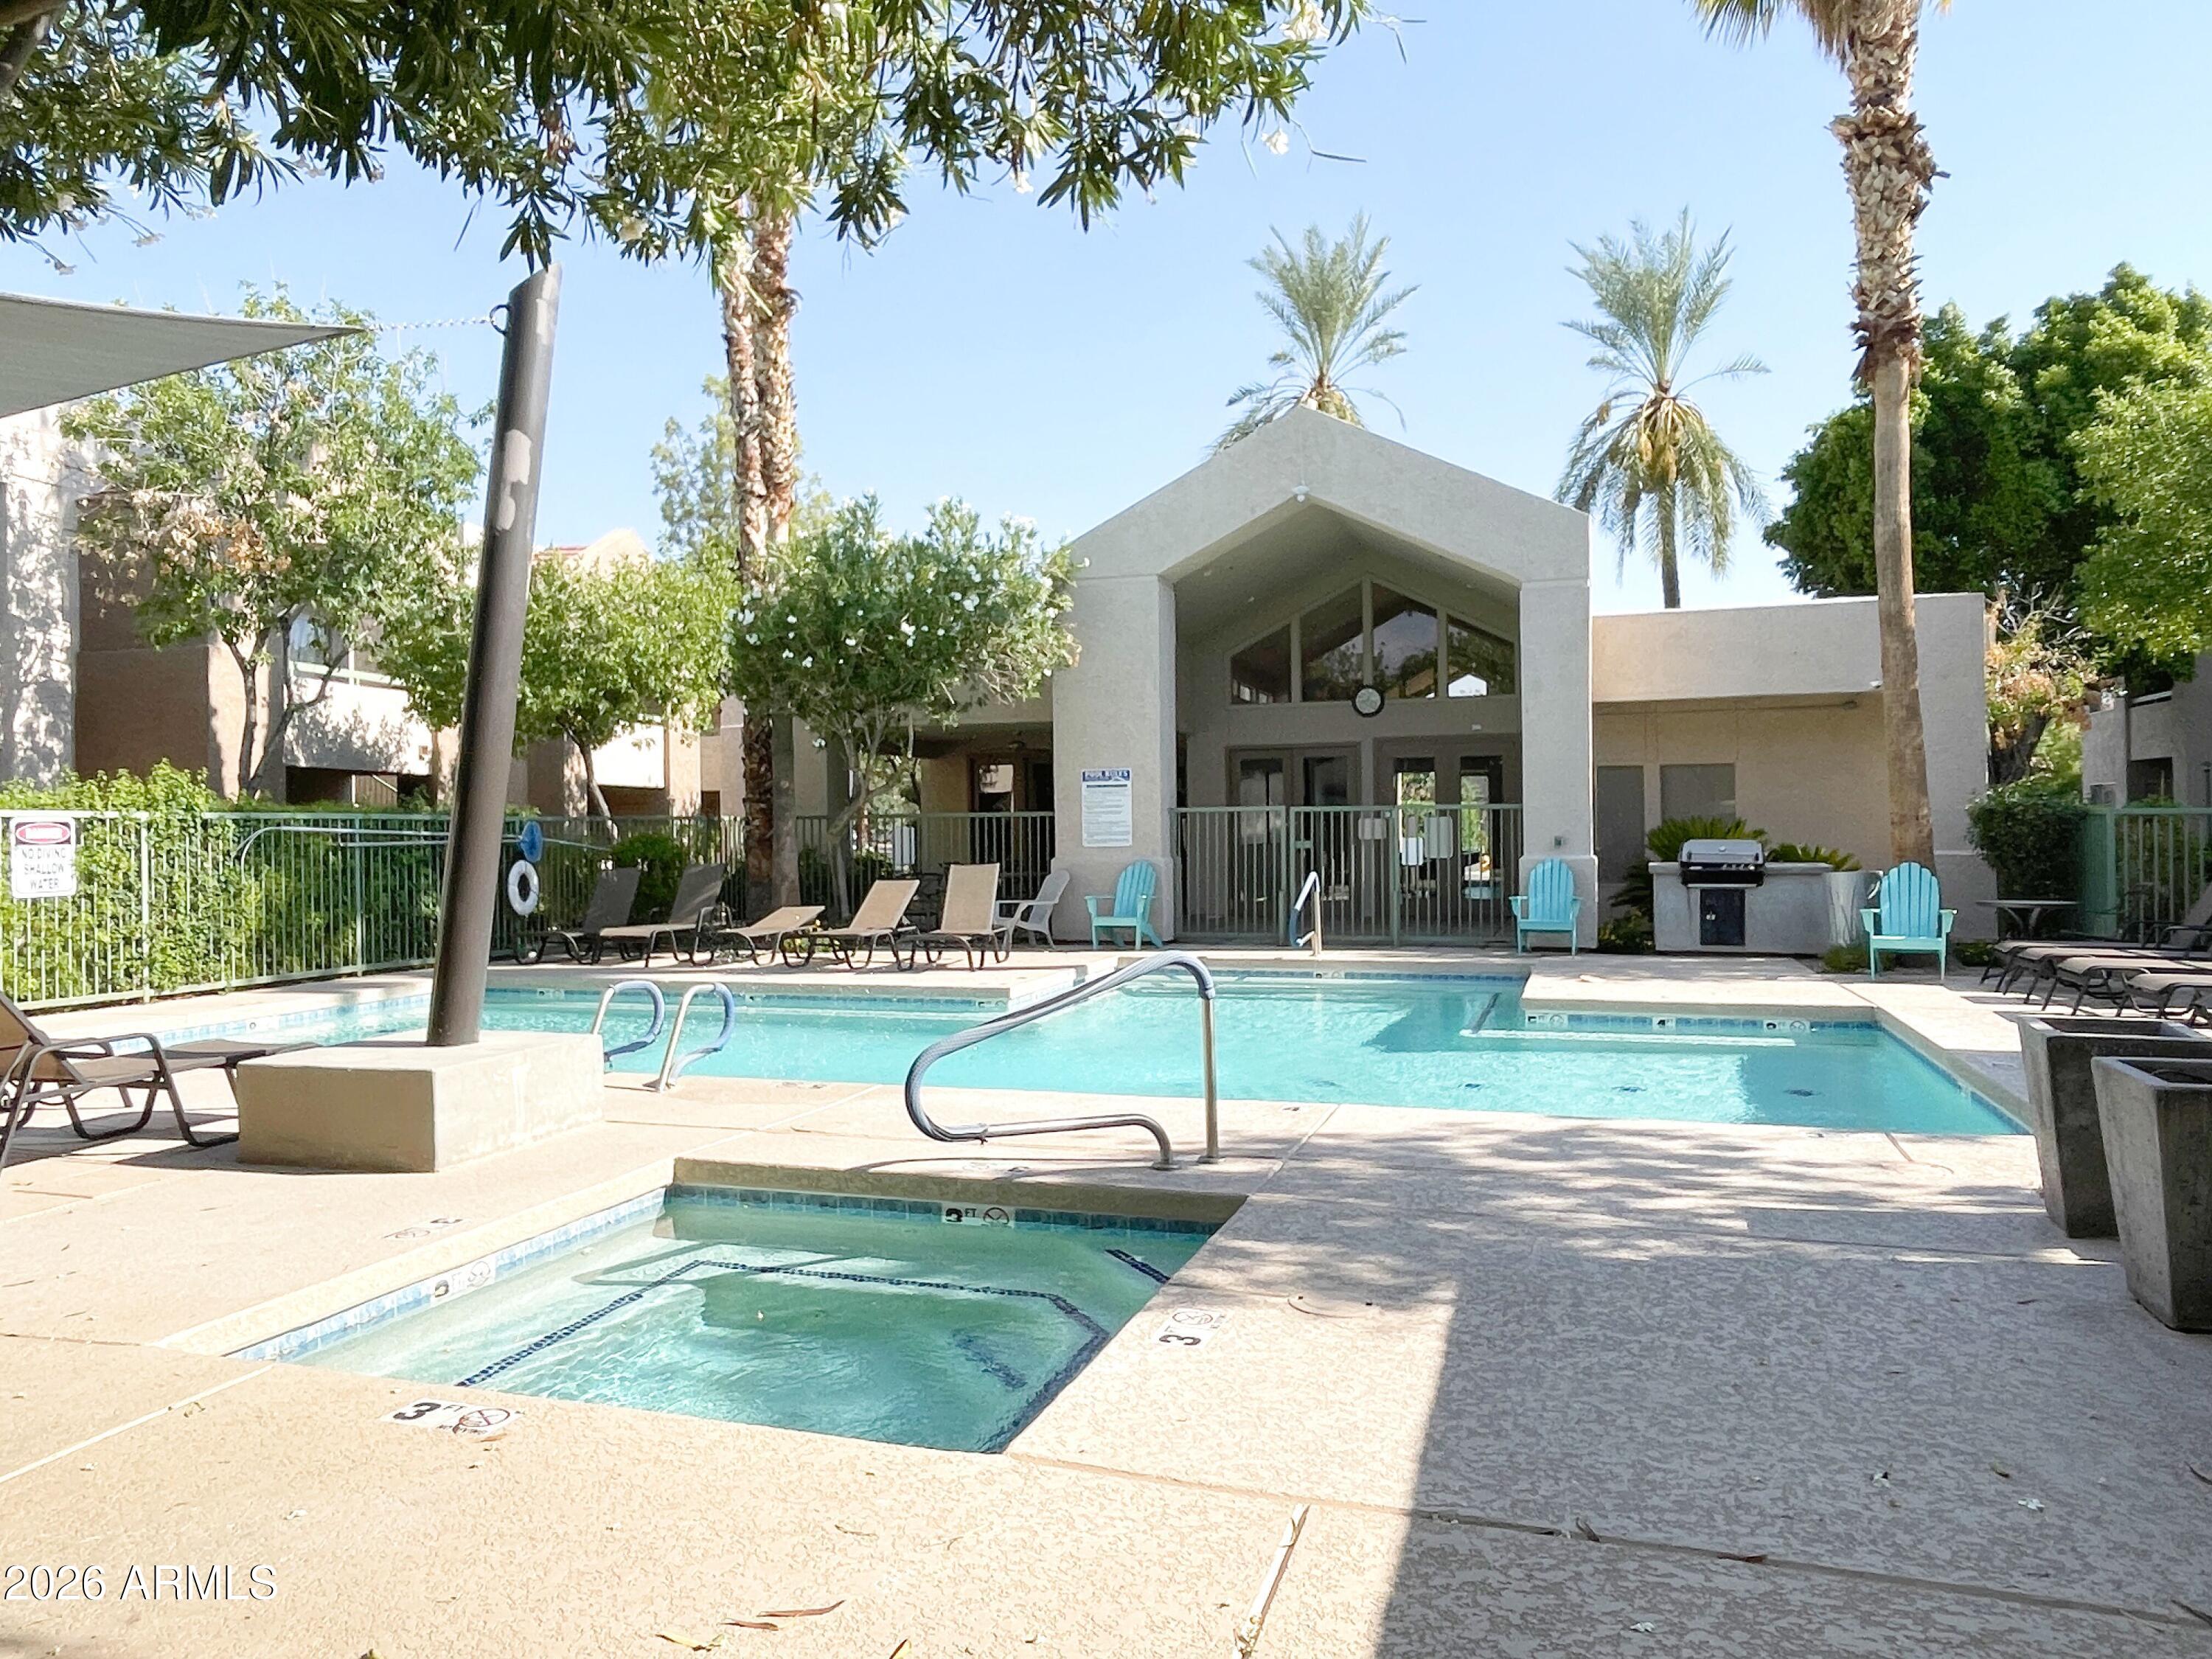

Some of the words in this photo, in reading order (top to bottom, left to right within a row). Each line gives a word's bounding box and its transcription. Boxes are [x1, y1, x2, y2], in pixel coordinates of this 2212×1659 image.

[22, 848, 34, 859] NO
[24, 863, 64, 874] SHALLOW
[29, 877, 60, 891] WATER
[392, 1402, 442, 1420] 3
